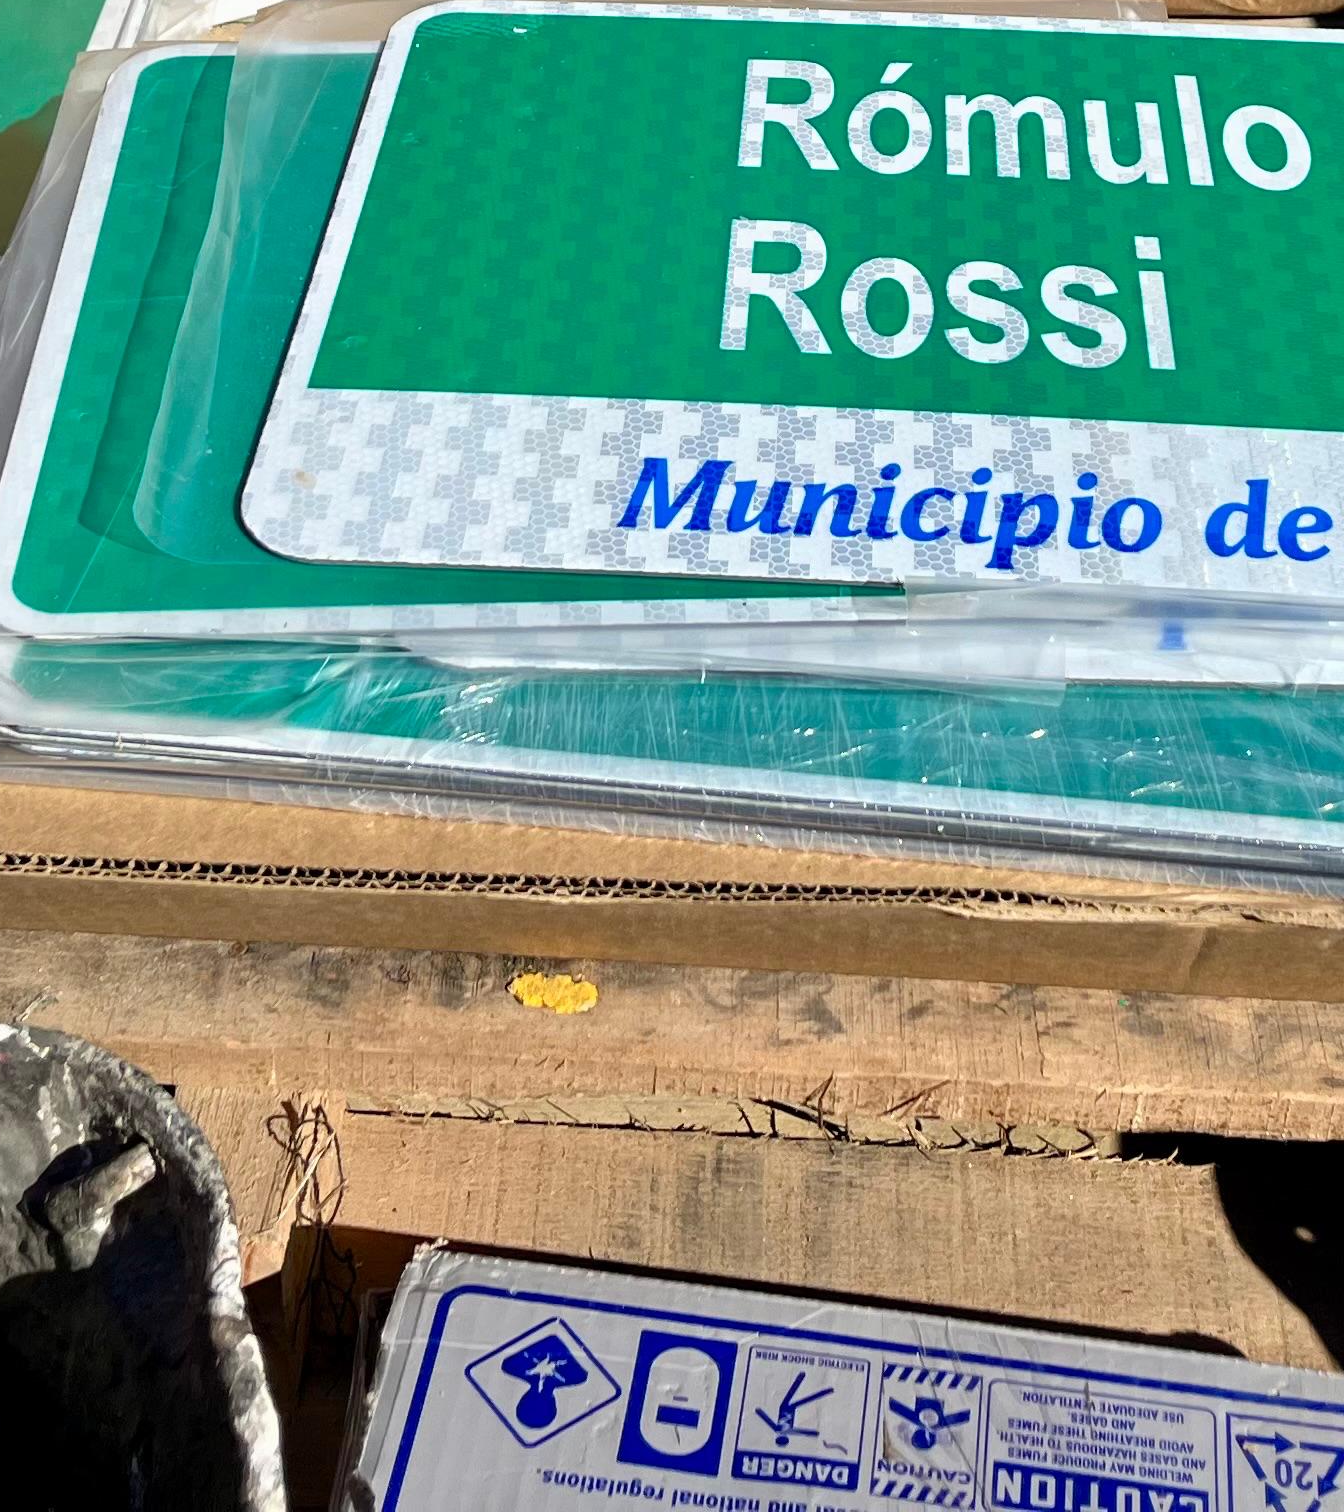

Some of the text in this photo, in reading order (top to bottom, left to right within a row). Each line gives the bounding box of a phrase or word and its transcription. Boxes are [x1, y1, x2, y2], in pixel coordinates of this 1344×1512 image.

[737, 57, 1313, 193] Rómulo
[719, 216, 1177, 371] Rossi
[618, 455, 1163, 570] Municipio
[1203, 479, 1334, 562] de
[1007, 1417, 1048, 1433] FUMES
[1111, 1418, 1136, 1431] AND
[1162, 1411, 1185, 1425] USE
[1140, 1451, 1179, 1467] GASES
[1159, 1440, 1194, 1454] AVOID
[741, 1455, 849, 1486] DANGER
[877, 1459, 972, 1485] CAUTION
[1007, 1446, 1194, 1484] WELDING MAY PRODUCE FUMES
[1181, 1458, 1206, 1471] AND
[1274, 1458, 1313, 1491] 20
[536, 1467, 664, 1502] regulations.
[672, 1489, 760, 1512] national
